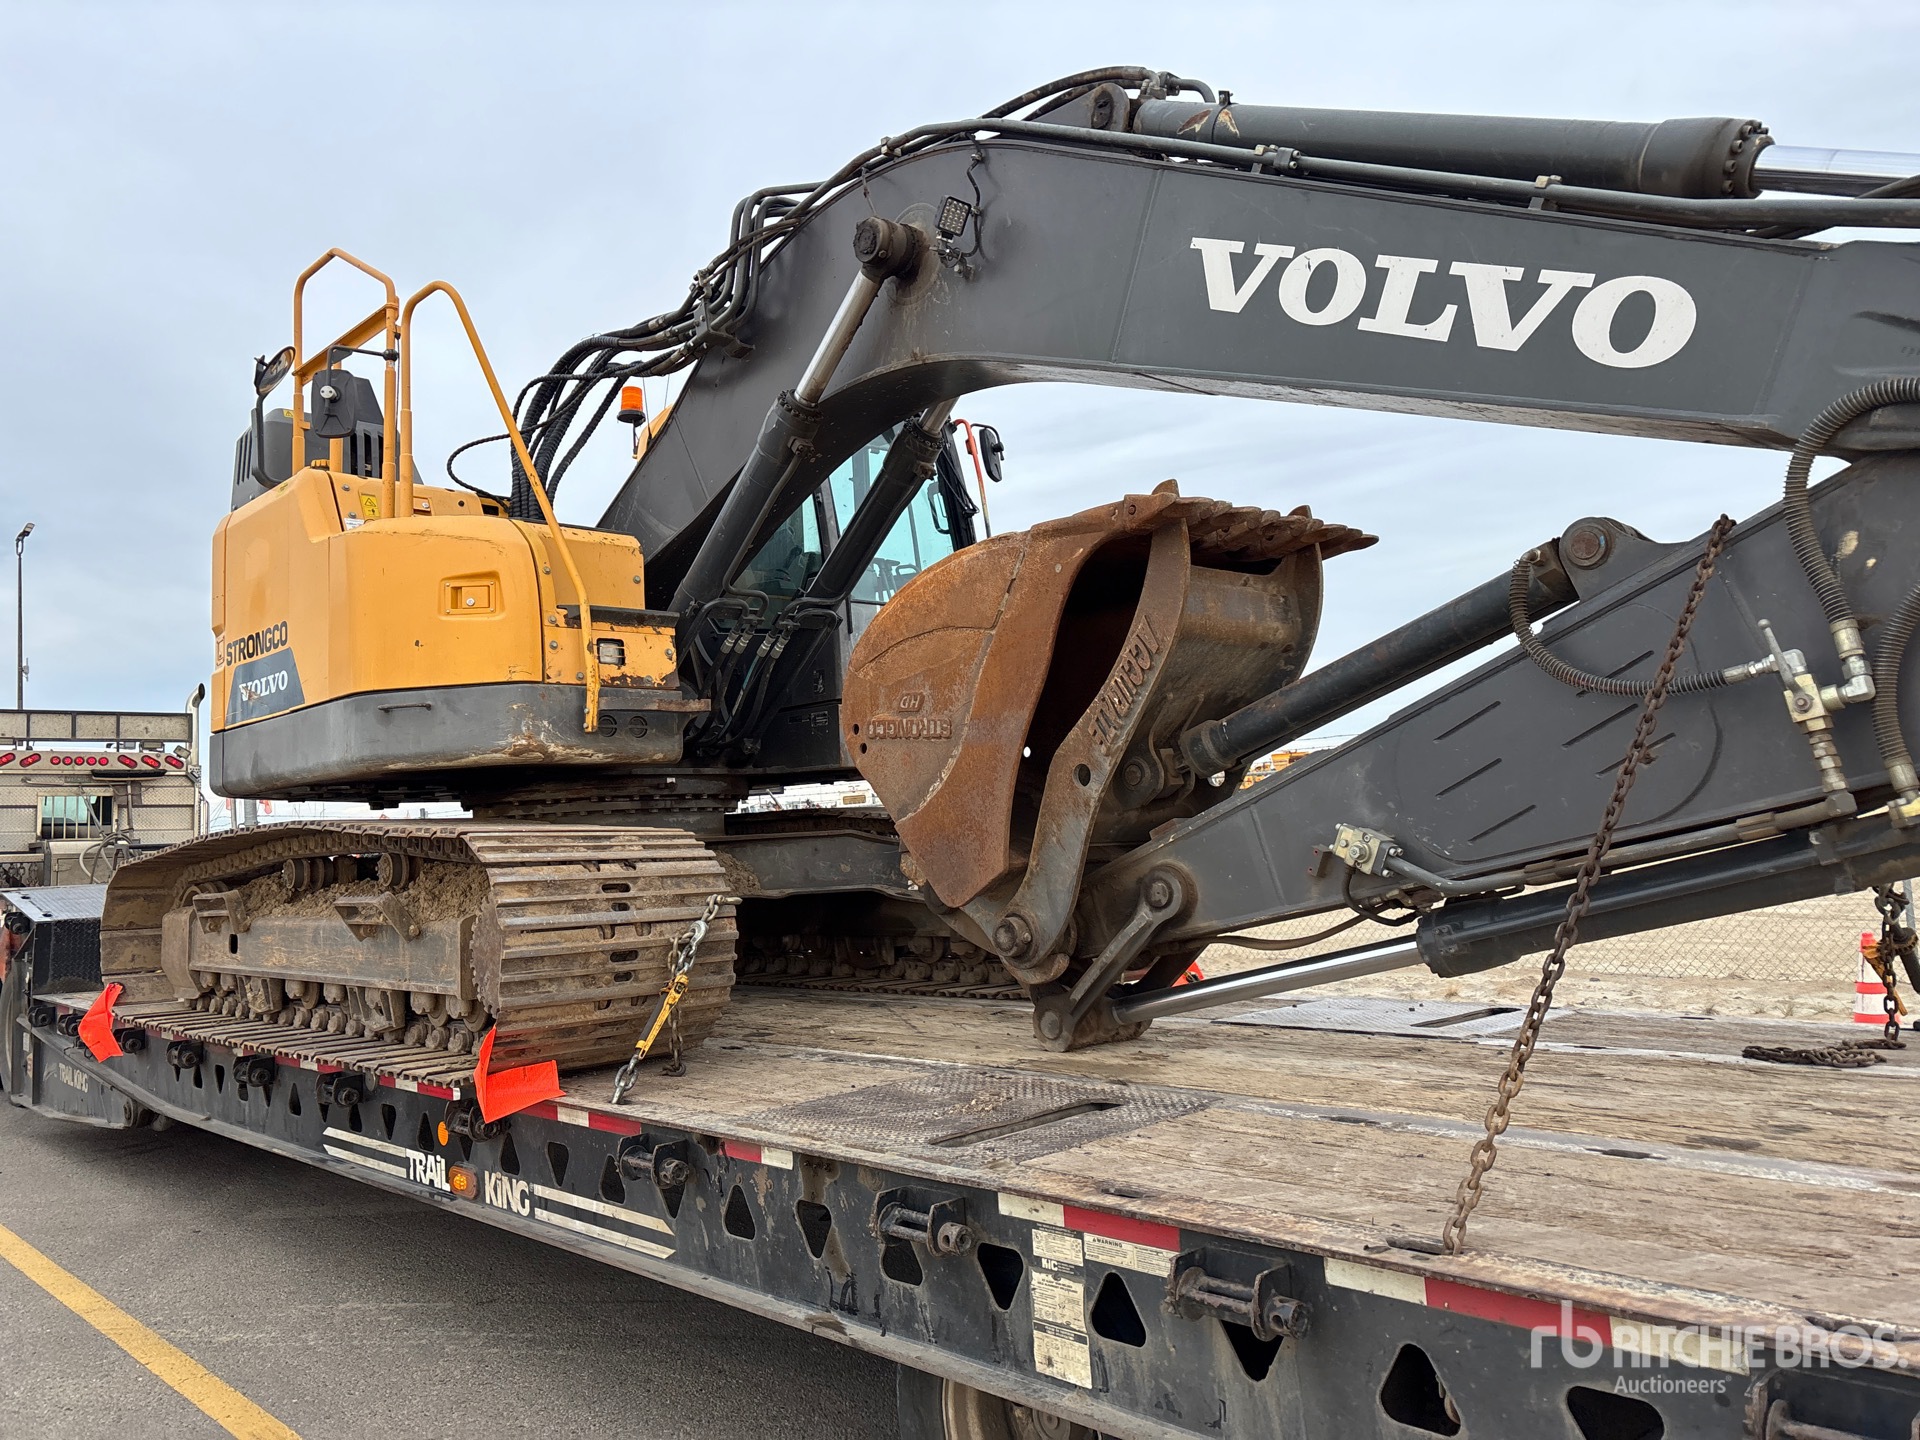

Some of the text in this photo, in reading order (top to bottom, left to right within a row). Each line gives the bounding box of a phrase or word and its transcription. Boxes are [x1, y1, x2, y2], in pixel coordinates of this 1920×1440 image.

[1190, 237, 1697, 368] VOLVO
[226, 620, 288, 666] STRONGCO
[239, 670, 288, 701] VOLVO
[1088, 614, 1159, 756] ACCURATE
[1097, 1237, 1123, 1248] WARNING
